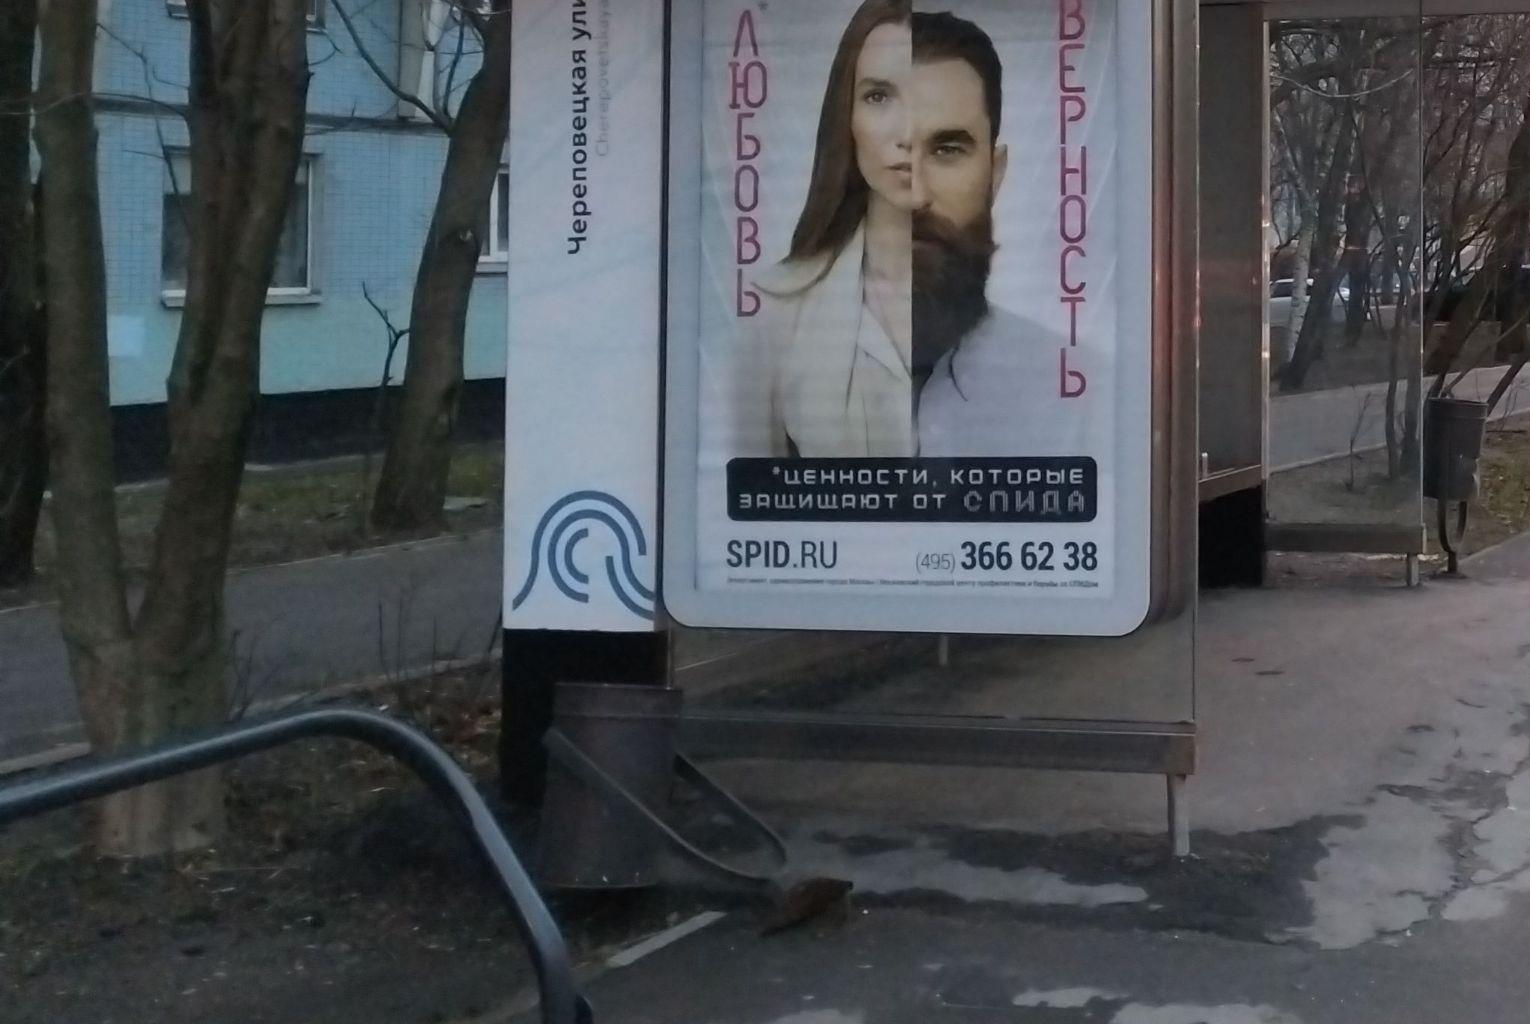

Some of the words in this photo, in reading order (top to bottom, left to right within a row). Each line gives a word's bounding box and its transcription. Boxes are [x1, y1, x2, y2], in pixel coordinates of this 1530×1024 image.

[567, 49, 592, 255] Череповецкая
[728, 9, 768, 317] ЛЮБОВЬ
[951, 468, 1084, 485] КОТОРЫЕ
[739, 493, 898, 510] ЗАЩИЩАЮТ
[913, 494, 947, 510] ОТ
[963, 490, 1085, 515] СПИДА
[726, 539, 838, 569] SPID.RU
[915, 552, 956, 575] (495)
[960, 541, 1013, 571] 366
[1020, 541, 1055, 571] 62
[1063, 541, 1098, 571] 38
